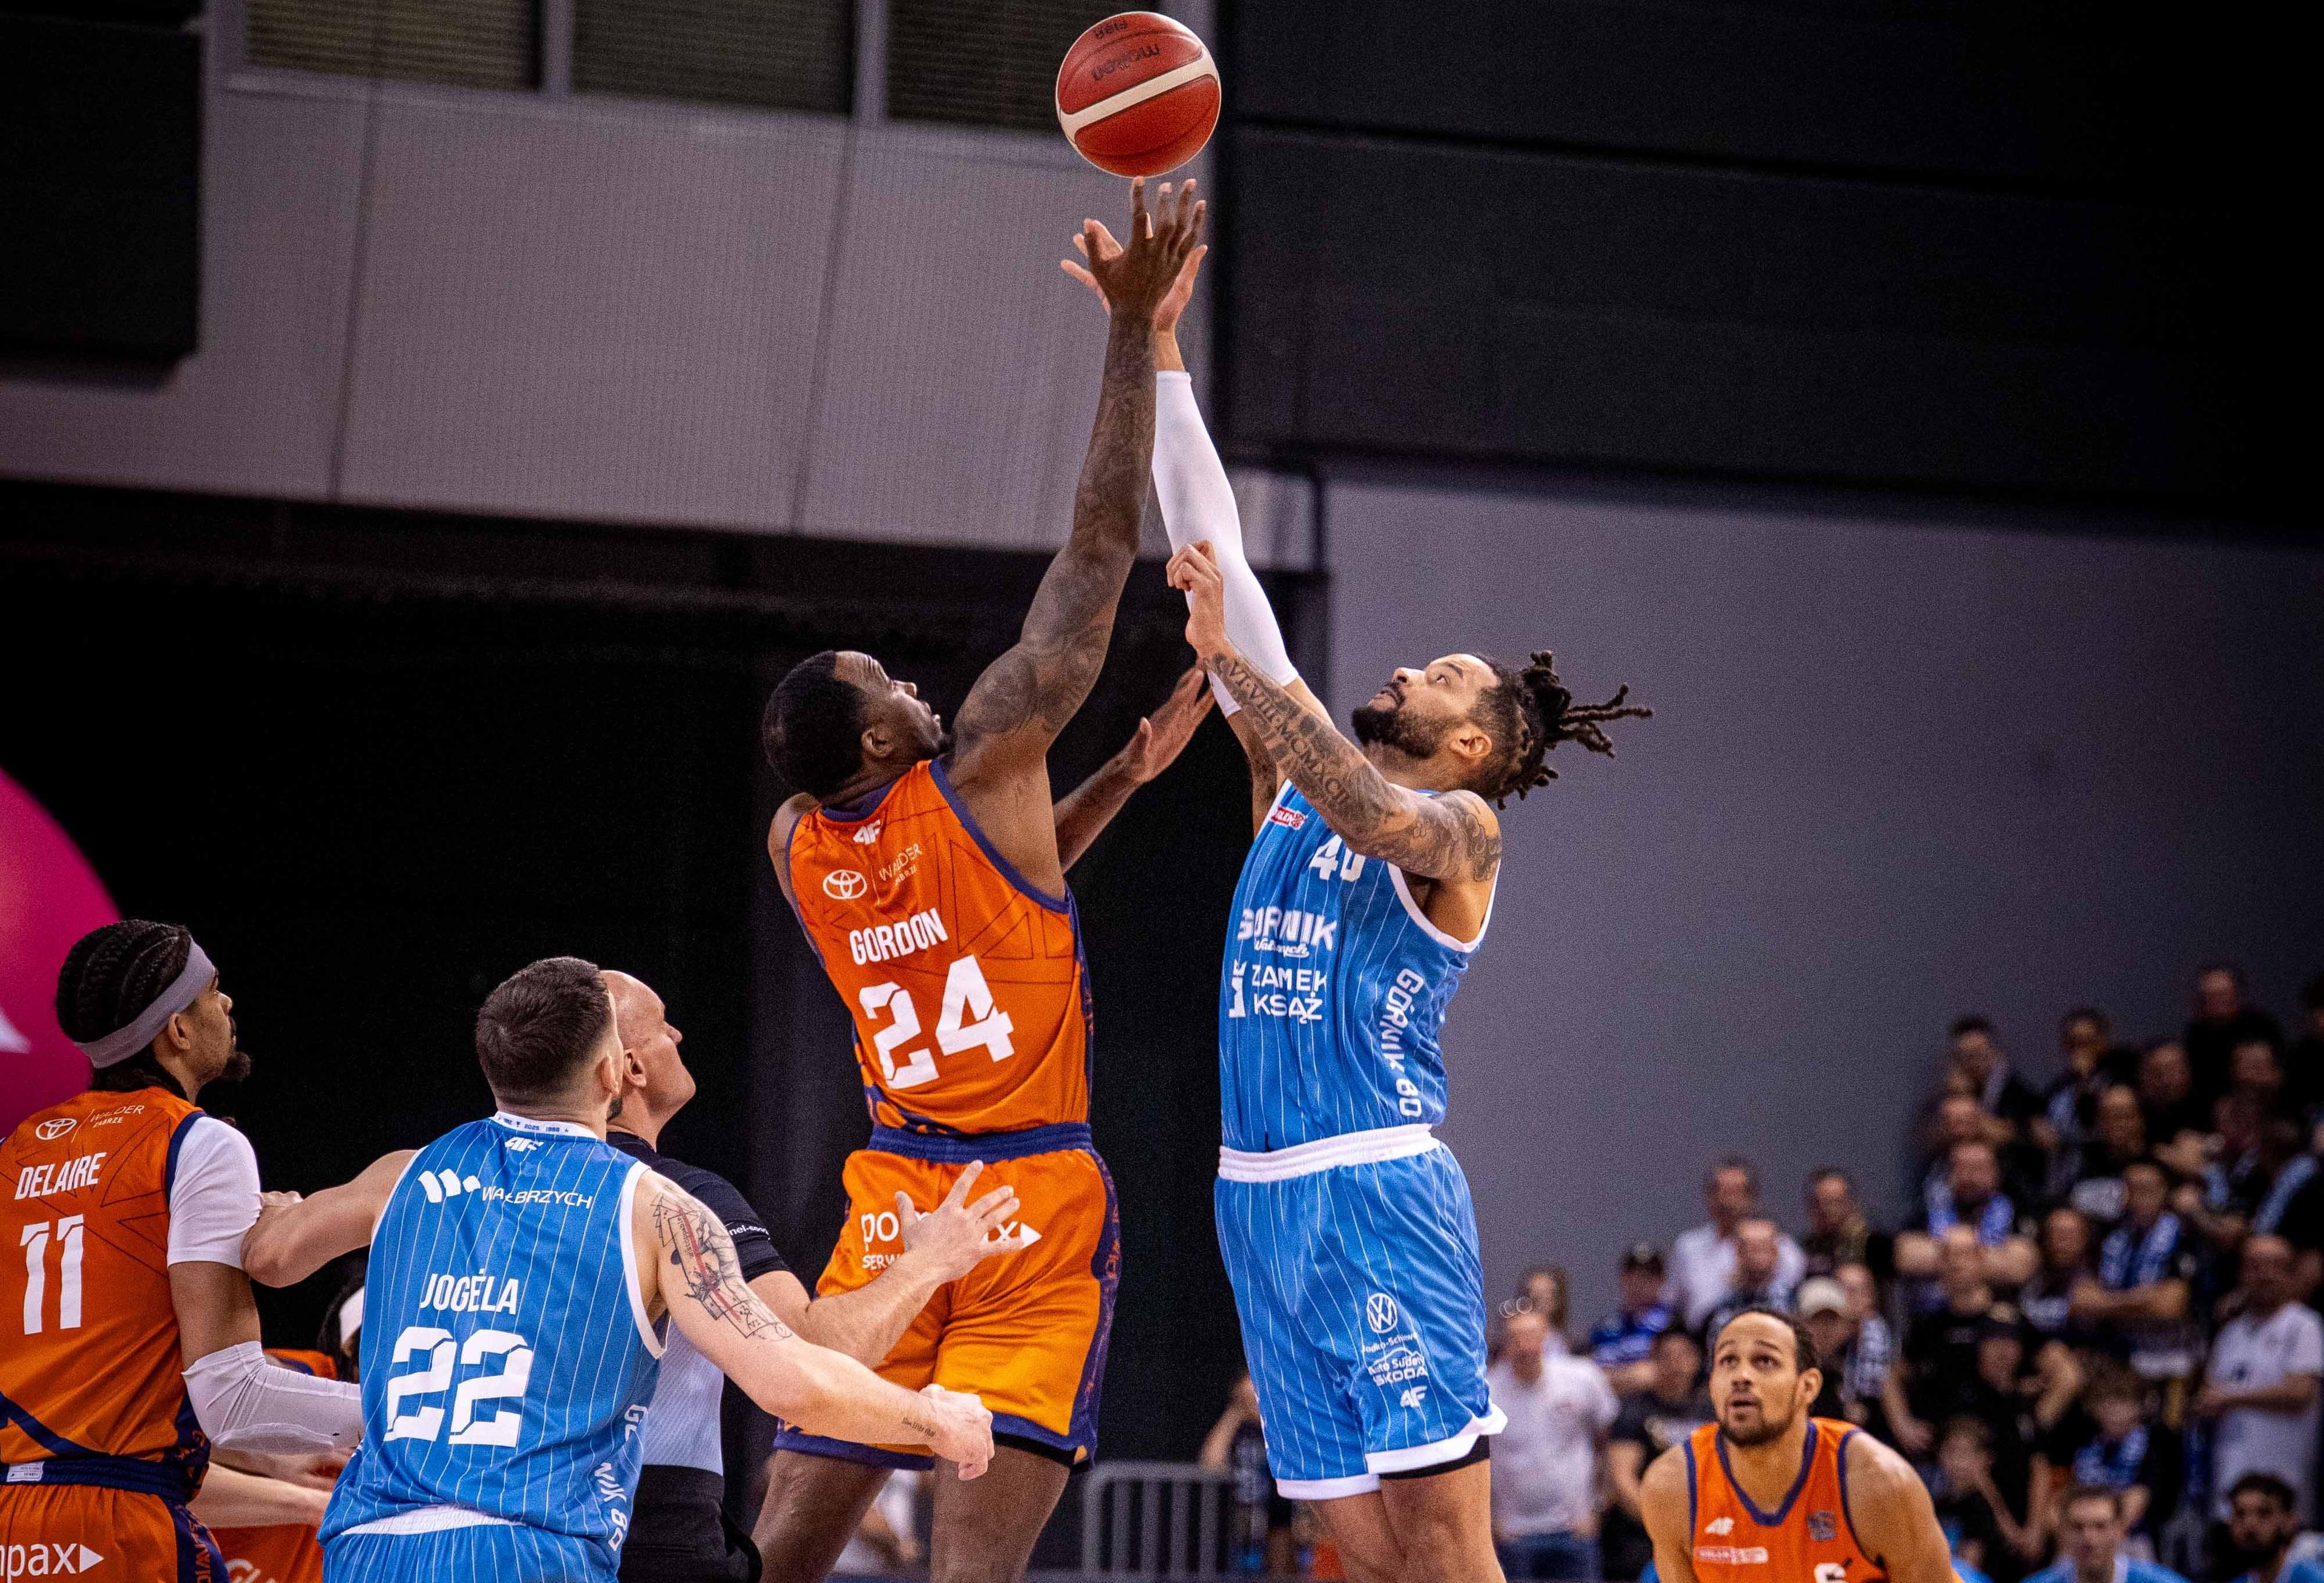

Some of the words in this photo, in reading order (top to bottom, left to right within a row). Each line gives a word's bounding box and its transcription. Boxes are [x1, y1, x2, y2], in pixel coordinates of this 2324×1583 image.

[849, 908, 948, 965] GORDON
[1252, 964, 1327, 992] ZAMEK
[859, 954, 1015, 1090] 24
[15, 1152, 107, 1200] DELAIRE
[19, 1214, 84, 1335] 11
[384, 1326, 533, 1447] 22
